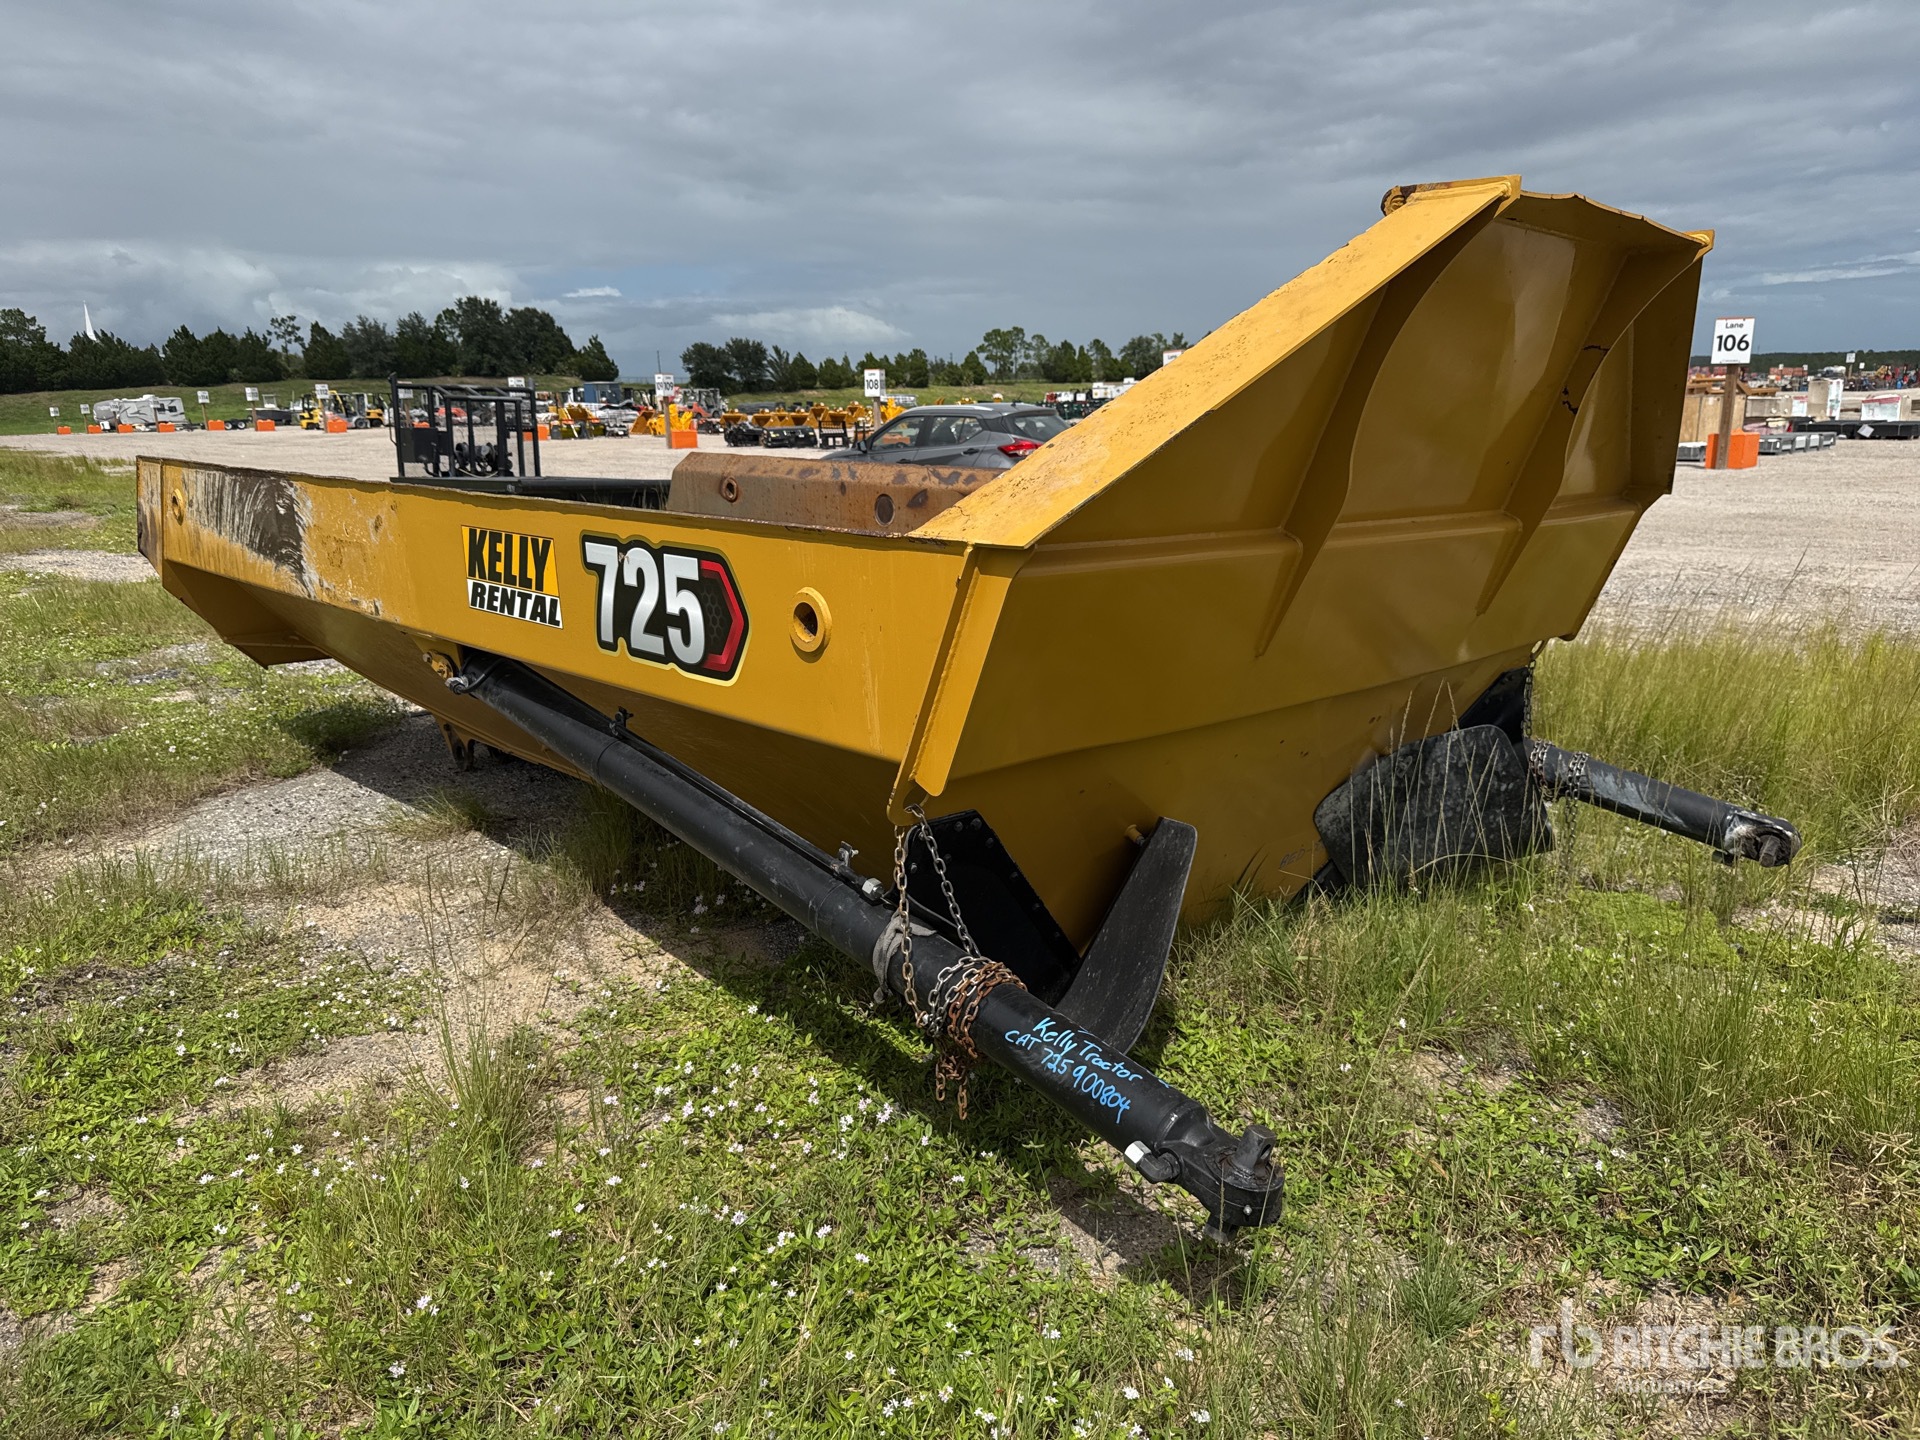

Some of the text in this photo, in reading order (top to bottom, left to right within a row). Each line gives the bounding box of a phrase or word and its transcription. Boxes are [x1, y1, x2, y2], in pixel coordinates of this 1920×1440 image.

[1716, 333, 1750, 352] 106
[664, 381, 674, 391] 109
[866, 379, 879, 390] 108
[468, 528, 552, 592] KELLY
[470, 581, 560, 627] RENTAL
[584, 541, 705, 664] 725
[1005, 1030, 1041, 1050] CAT
[1073, 1065, 1132, 1124] 900804
[1033, 1017, 1143, 1083] Kelly Tractor
